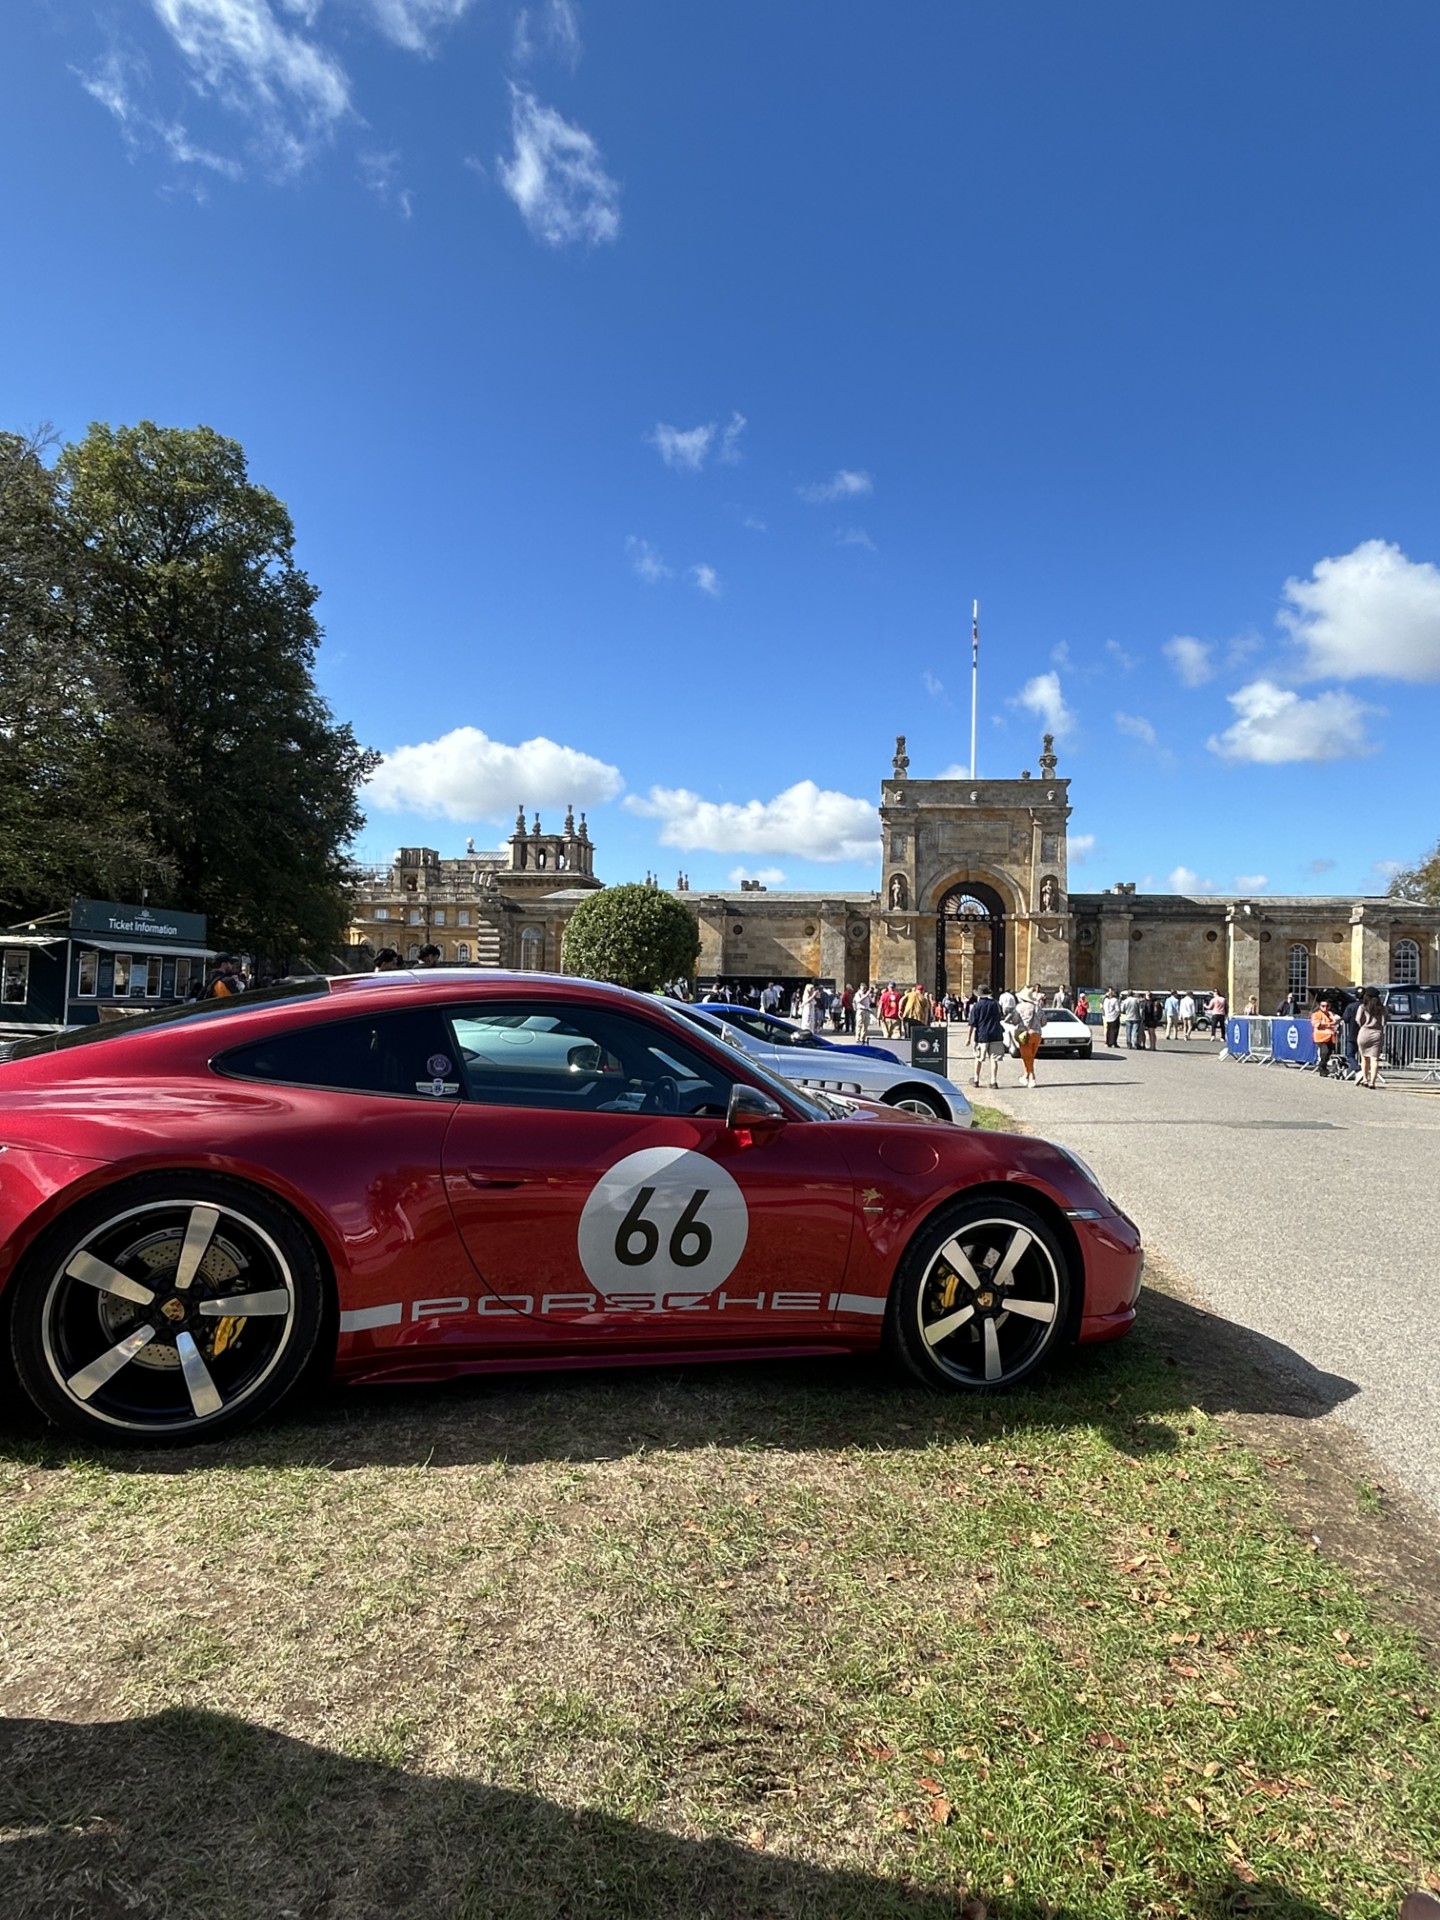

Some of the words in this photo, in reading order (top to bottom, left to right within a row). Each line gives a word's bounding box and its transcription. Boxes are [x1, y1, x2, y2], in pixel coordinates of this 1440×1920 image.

[108, 918, 133, 931] Ticket
[134, 921, 177, 935] Information
[615, 1187, 712, 1267] 66
[411, 1292, 821, 1321] PORSCHE
